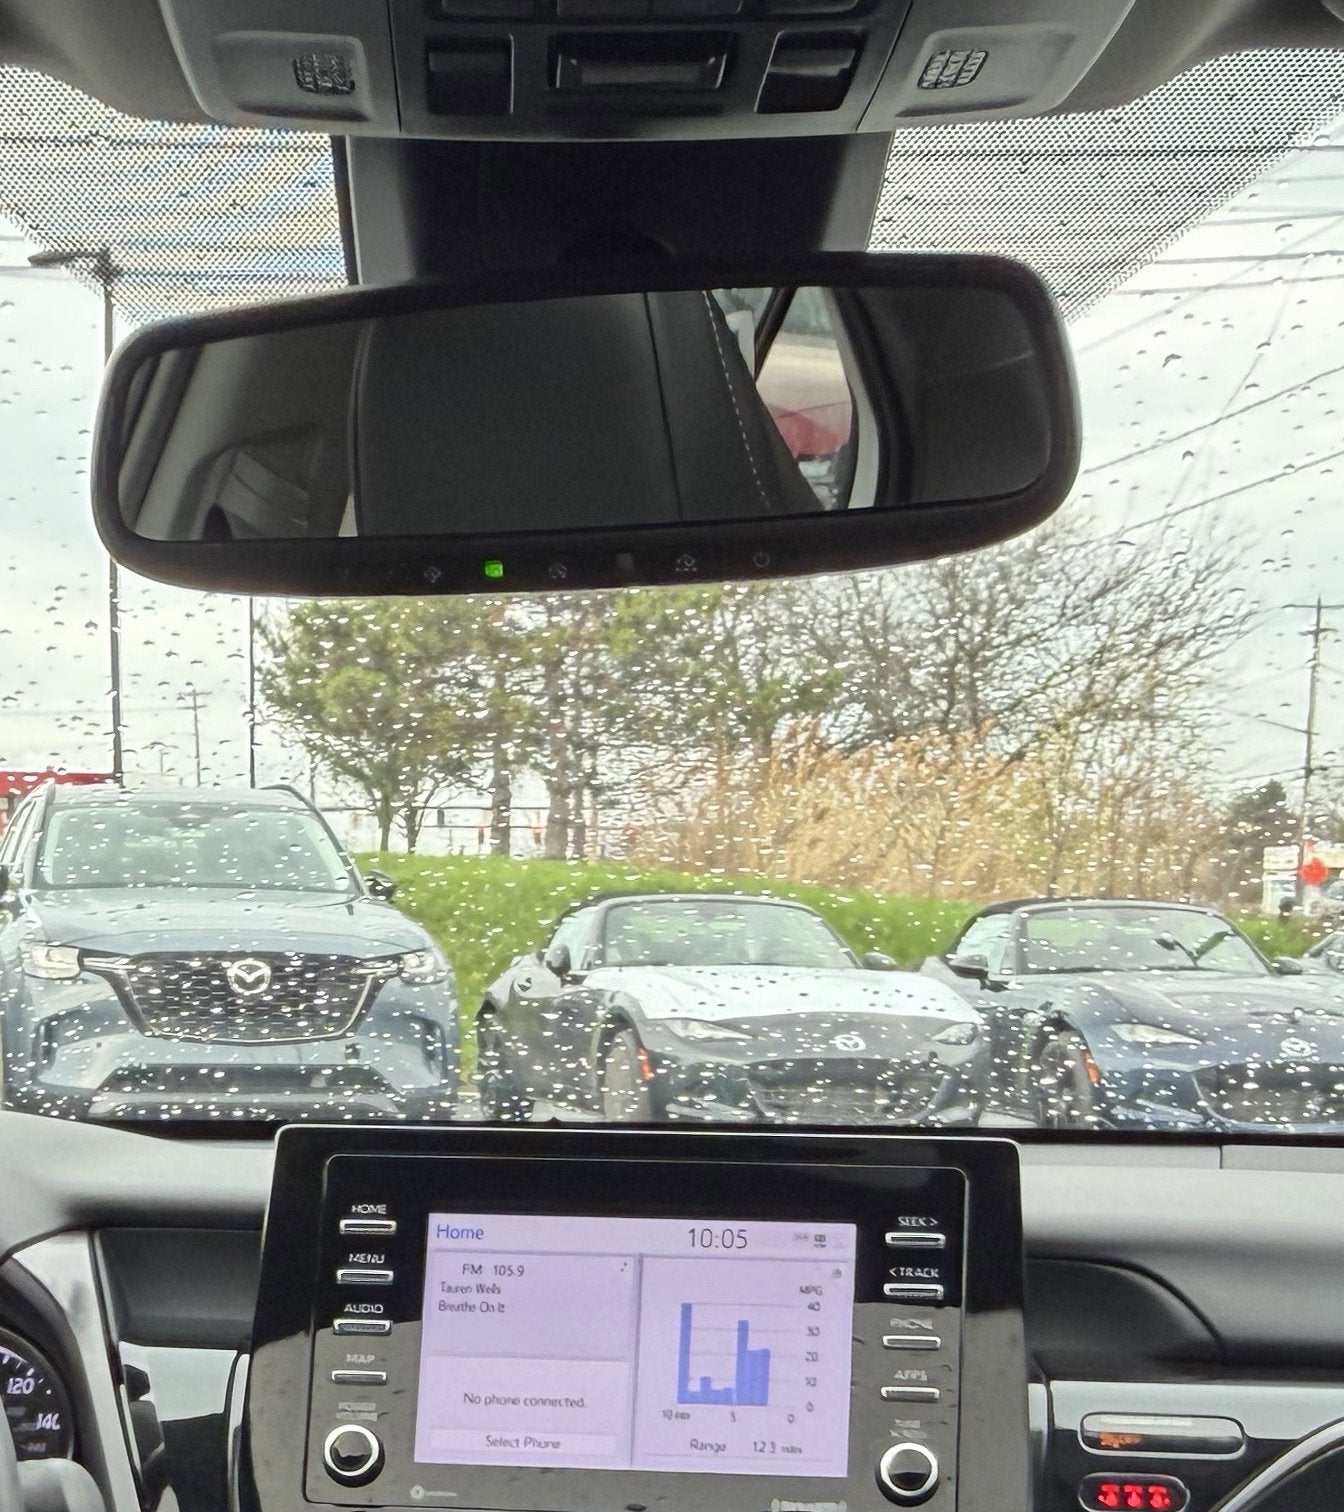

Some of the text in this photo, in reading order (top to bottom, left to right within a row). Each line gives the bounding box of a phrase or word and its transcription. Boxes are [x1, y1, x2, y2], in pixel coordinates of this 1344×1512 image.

[351, 1204, 387, 1215] HOME
[436, 1224, 484, 1240] Home
[687, 1228, 748, 1249] 10:05
[349, 1253, 385, 1264] MENU
[462, 1264, 483, 1275] FM
[899, 1266, 939, 1278] TRACK
[344, 1303, 384, 1314] AUDIO
[7, 1377, 35, 1395] 120
[463, 1392, 481, 1405] No
[484, 1394, 520, 1407] phone
[486, 1434, 519, 1448] Select
